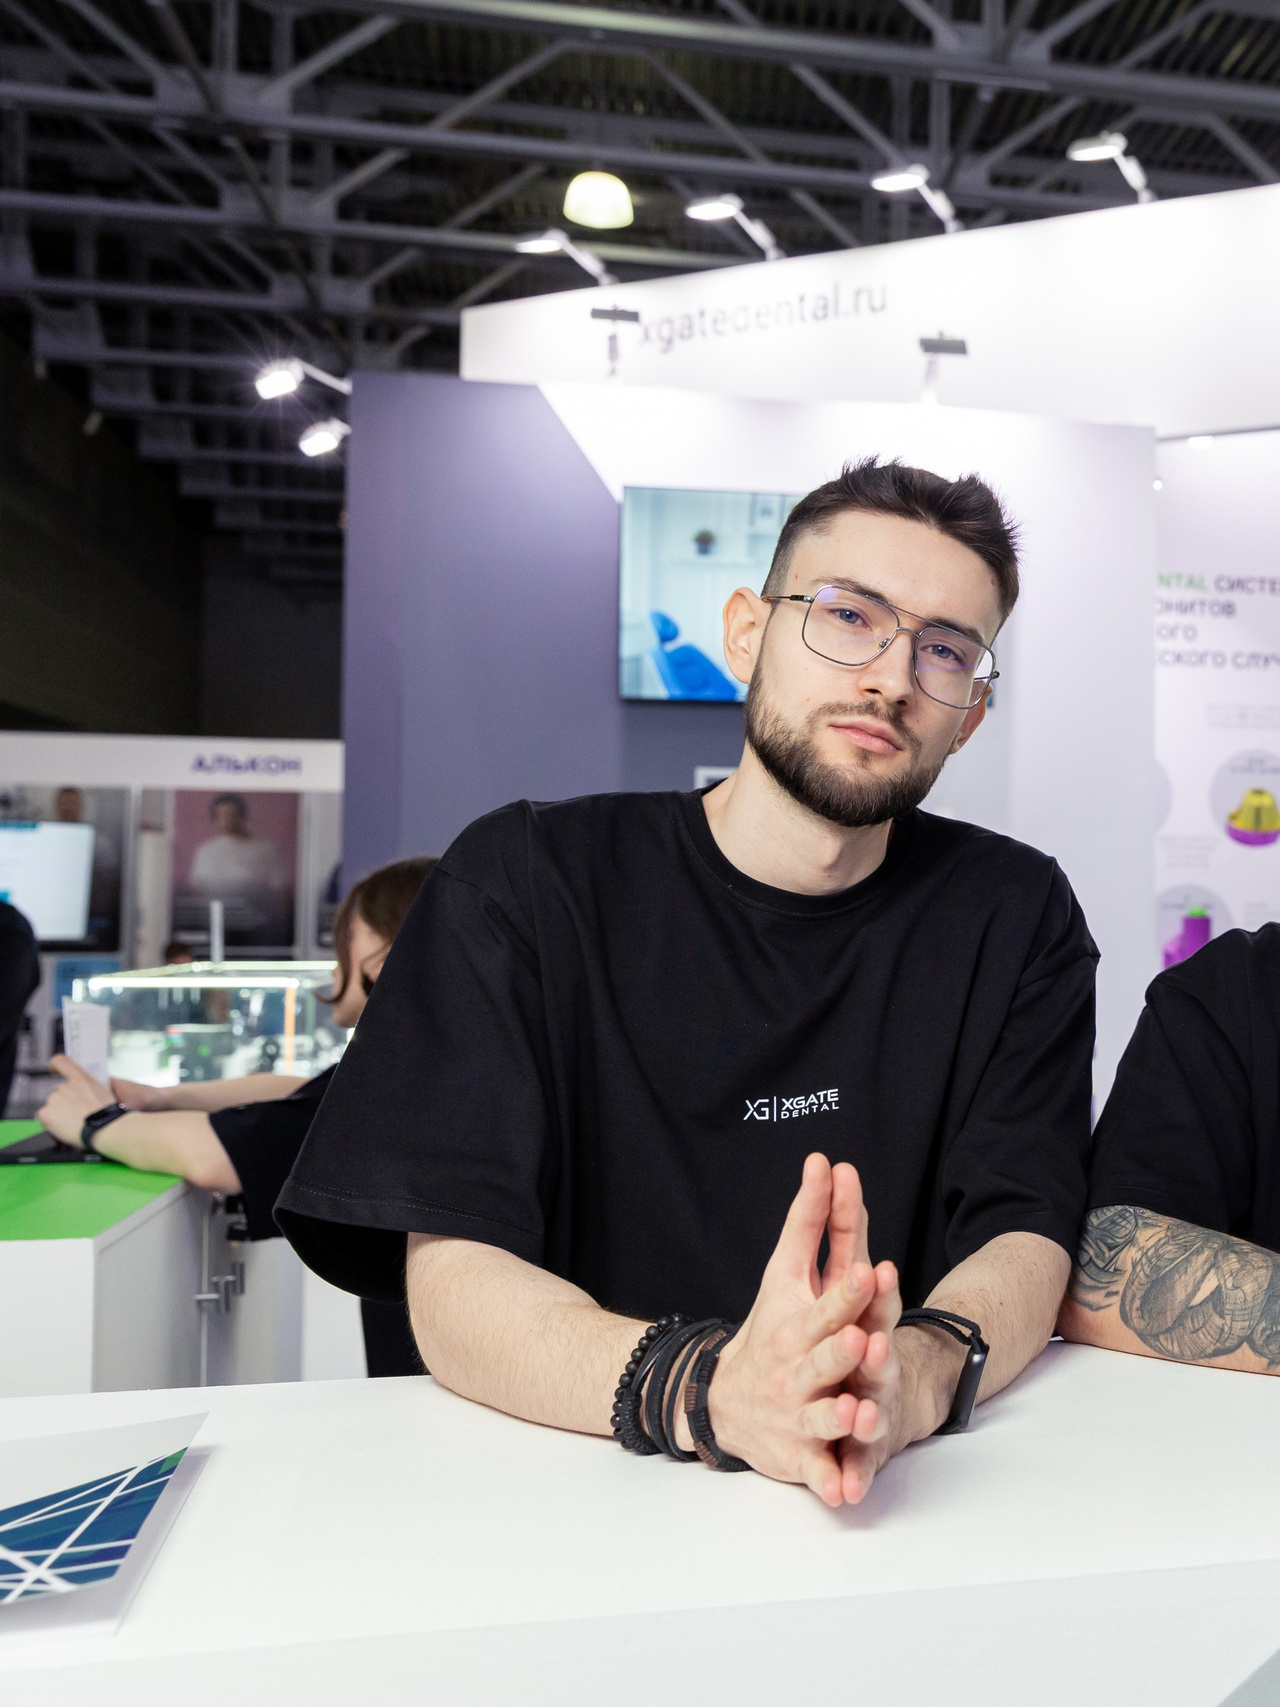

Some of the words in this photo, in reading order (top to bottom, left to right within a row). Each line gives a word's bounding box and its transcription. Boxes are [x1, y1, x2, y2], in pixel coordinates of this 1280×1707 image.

[641, 281, 888, 354] xgatedental.ru
[743, 1099, 769, 1120] XG
[781, 1088, 839, 1110] XGATE
[781, 1102, 840, 1119] DENTAL
